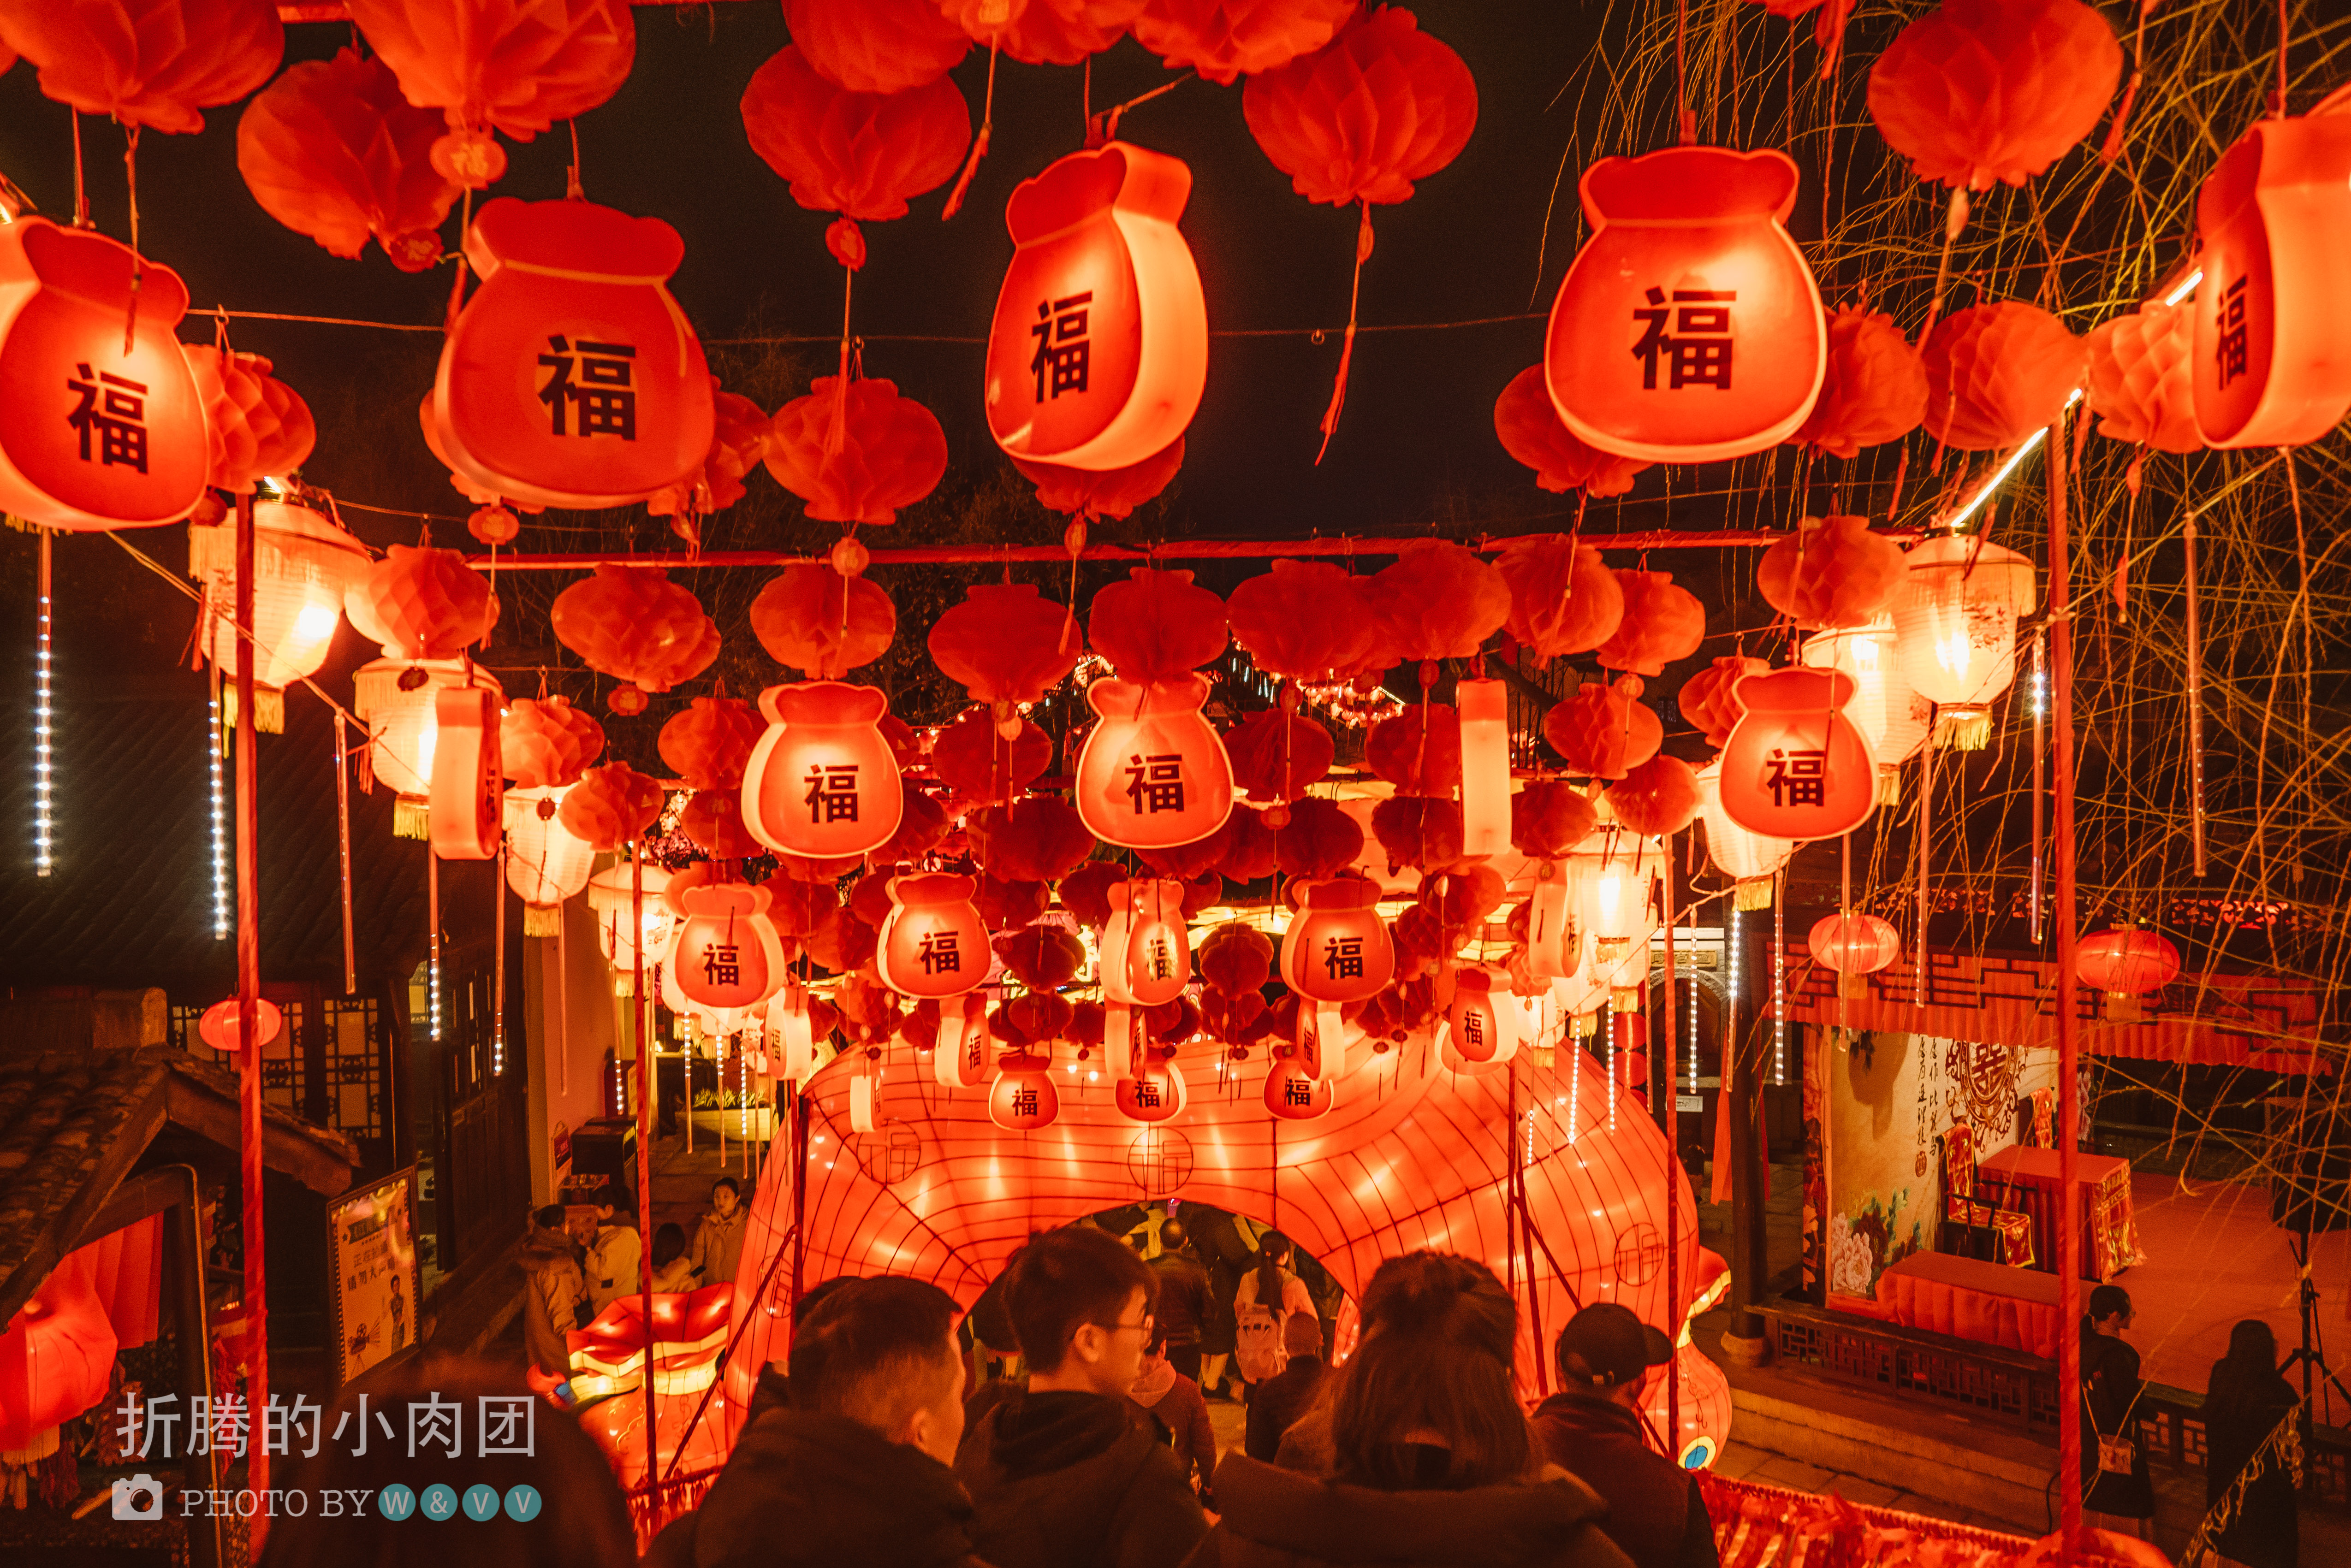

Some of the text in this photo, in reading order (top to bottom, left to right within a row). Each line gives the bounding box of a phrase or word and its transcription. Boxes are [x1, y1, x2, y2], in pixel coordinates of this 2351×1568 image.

[1030, 290, 1093, 404] 福
[1631, 285, 1737, 390] 福
[2216, 273, 2248, 391] 福
[538, 334, 636, 441] 福
[66, 363, 149, 475] 福
[804, 764, 859, 823] 福
[1125, 754, 1185, 815] 福
[1766, 749, 1825, 807] 福
[703, 943, 739, 986] 福
[919, 931, 961, 974] 福
[1146, 939, 1172, 982] 福
[1324, 937, 1364, 980] 福
[1303, 1029, 1313, 1065] 福
[1464, 1010, 1483, 1047] 福
[968, 1035, 982, 1071] 福
[1011, 1089, 1039, 1116] 福
[1135, 1081, 1160, 1107] 福
[1286, 1078, 1311, 1106] 福
